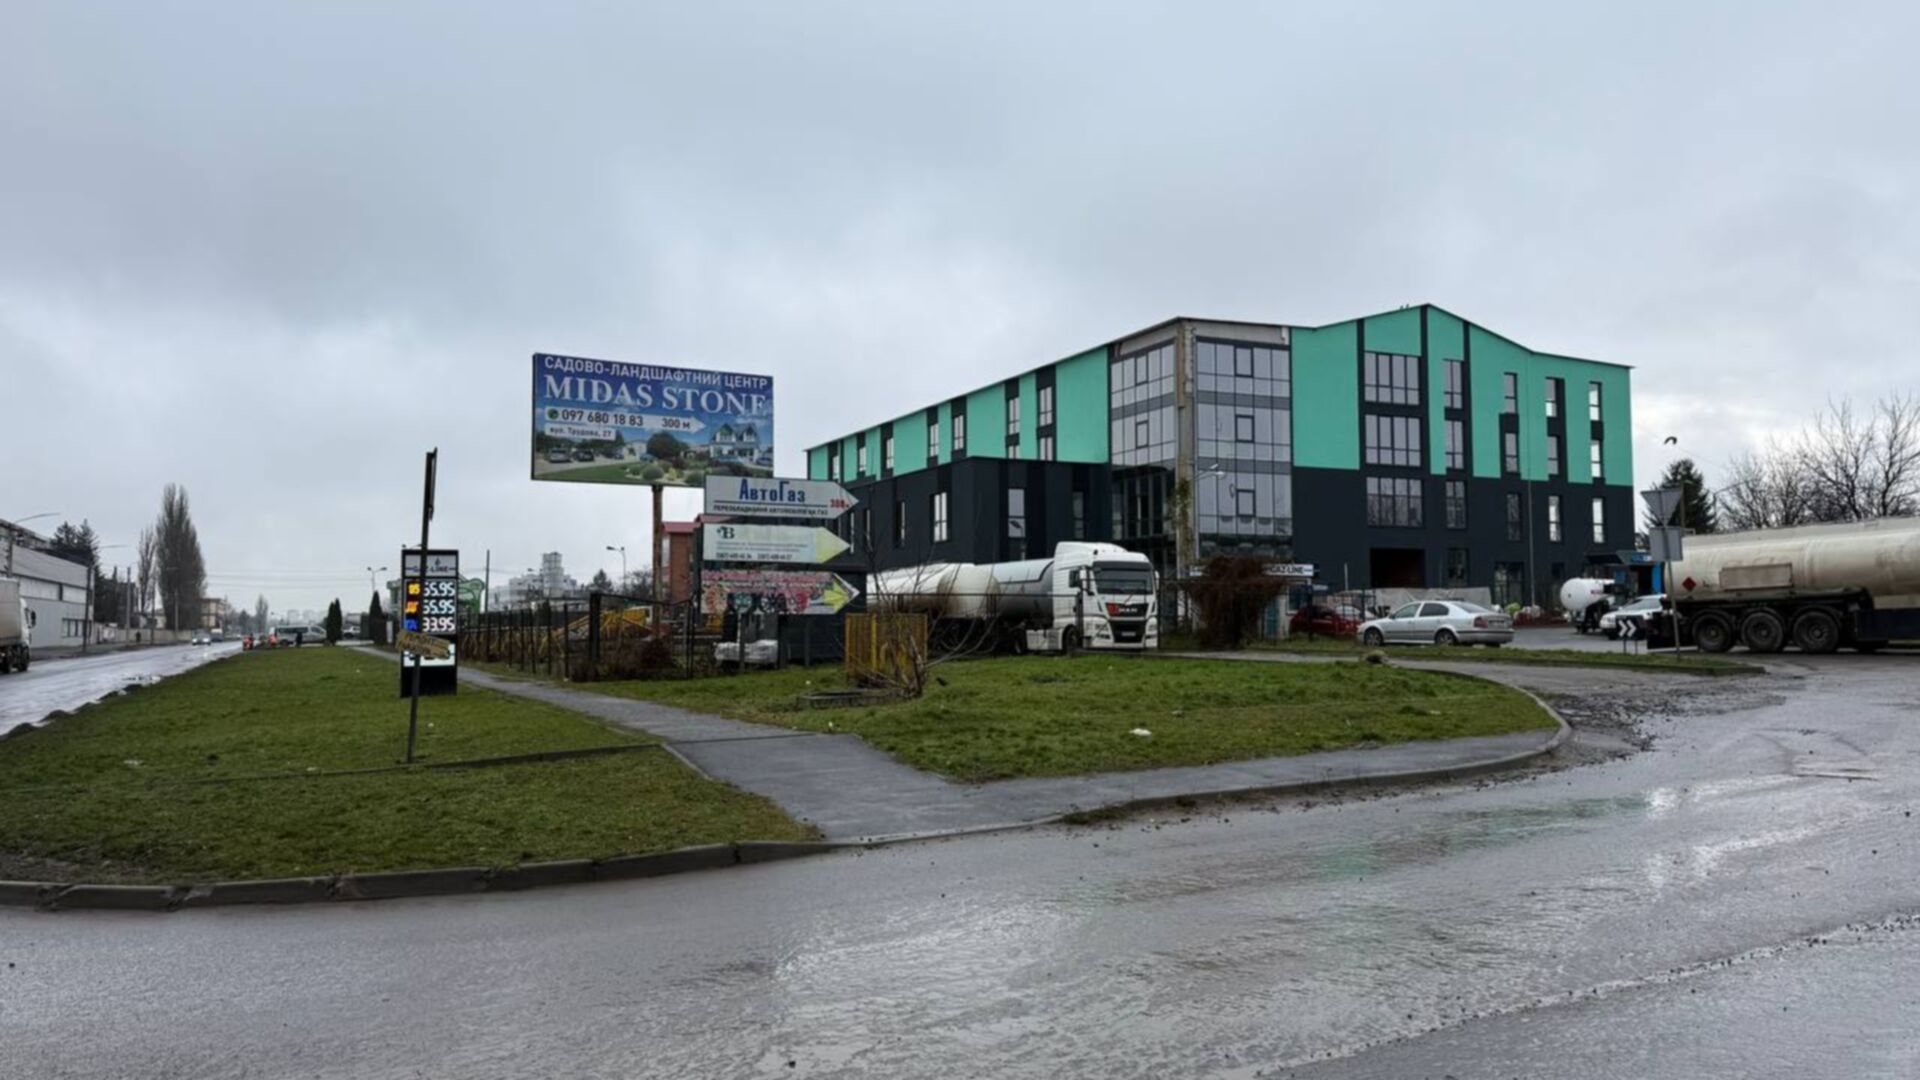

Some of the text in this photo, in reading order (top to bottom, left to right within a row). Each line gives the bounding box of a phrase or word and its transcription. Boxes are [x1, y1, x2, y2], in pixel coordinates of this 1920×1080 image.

[544, 356, 768, 390] САДОВО-ЛАНДШАФТНИЙ ЦЕНТР
[544, 374, 767, 416] MIDAS STONE
[561, 408, 583, 422] 097
[587, 410, 609, 425] 680
[613, 413, 626, 426] 18
[629, 413, 643, 427] 83
[662, 417, 681, 429] 300
[739, 478, 806, 502] АвтоГаз
